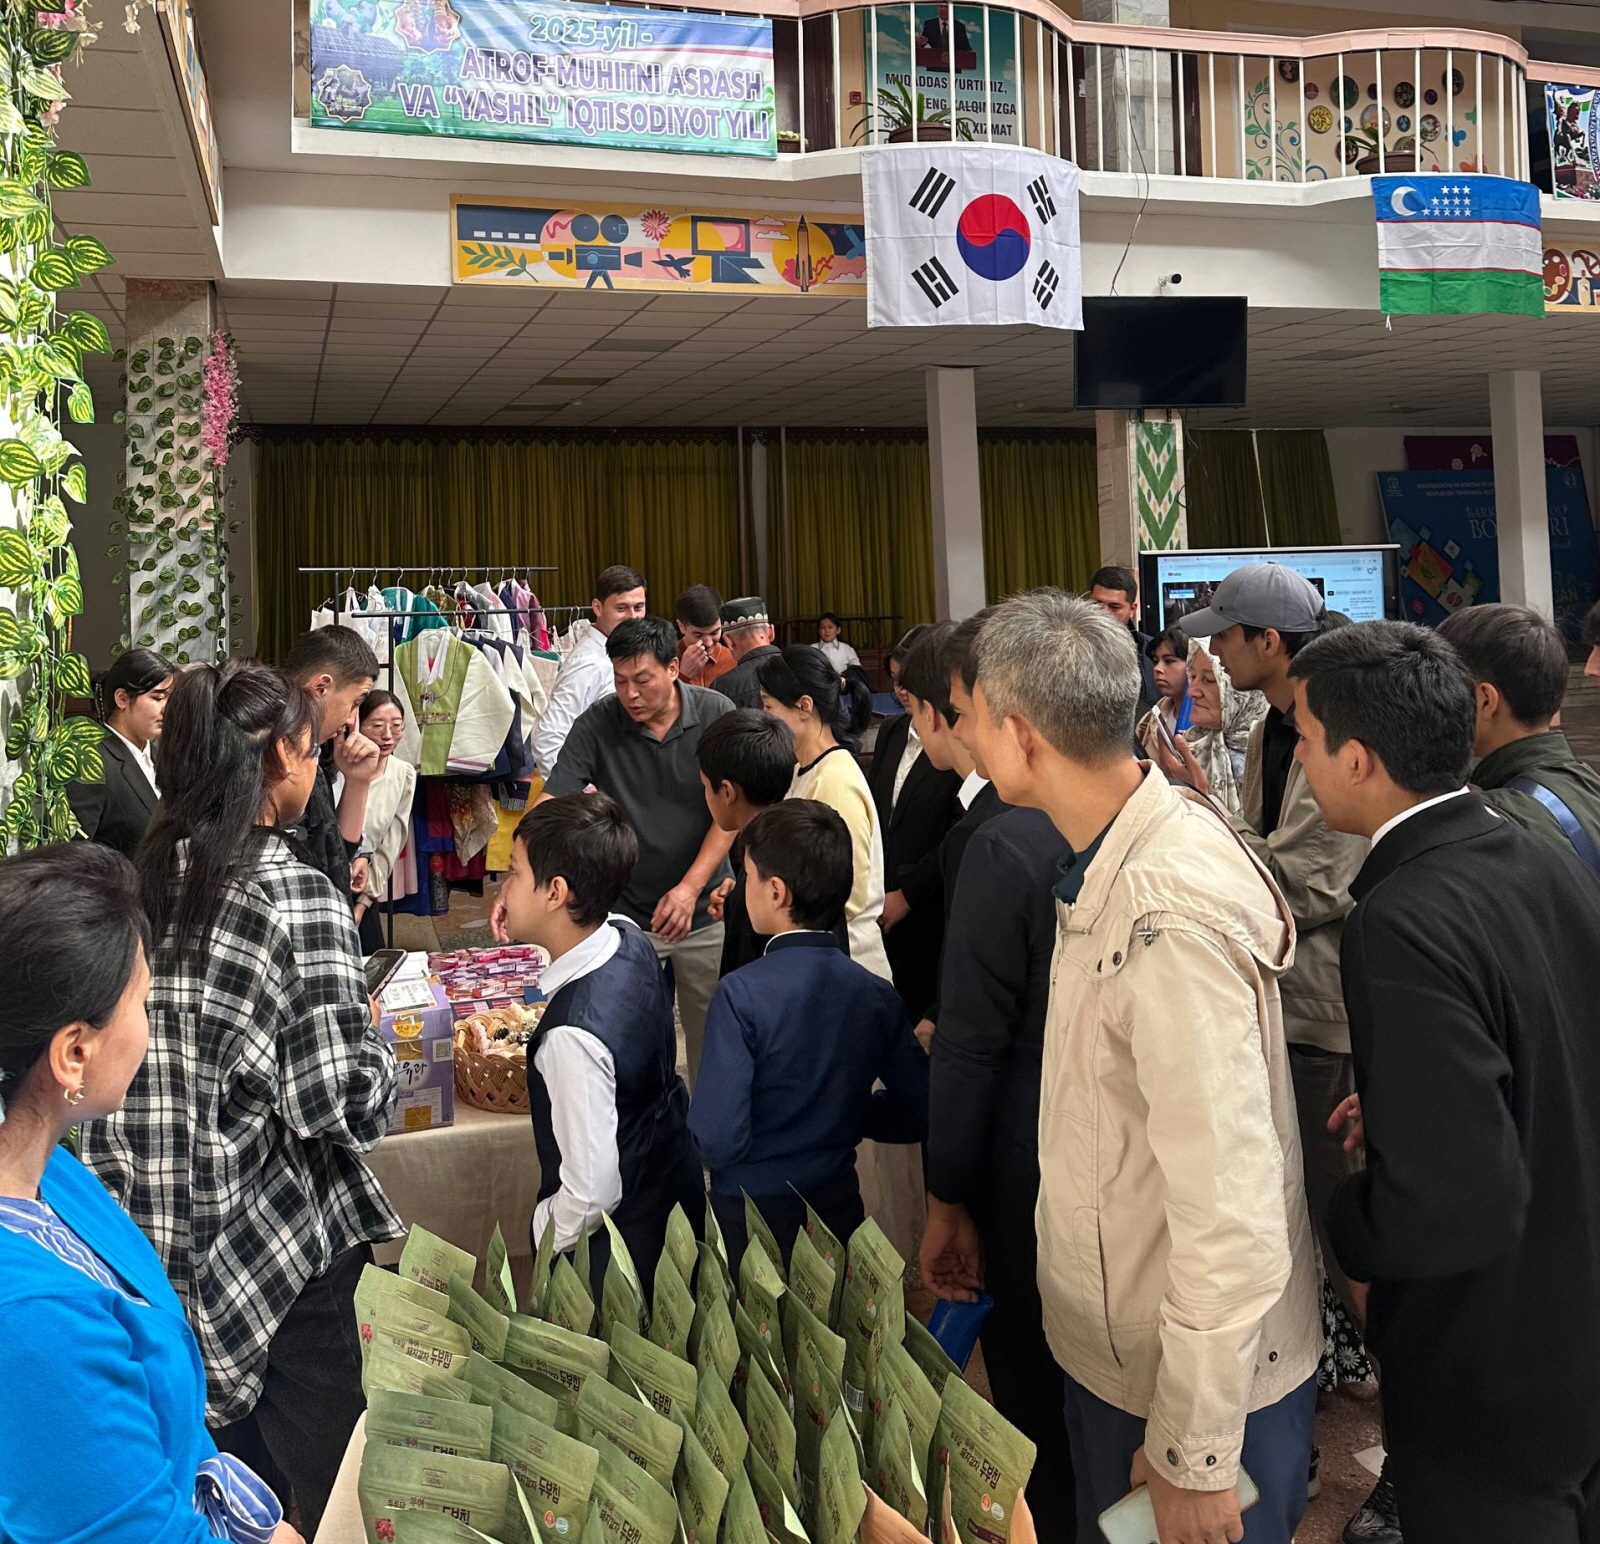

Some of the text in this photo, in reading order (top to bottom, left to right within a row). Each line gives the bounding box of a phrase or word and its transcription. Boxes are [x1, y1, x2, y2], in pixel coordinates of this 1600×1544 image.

[530, 16, 638, 53] 2025-yil
[461, 49, 762, 101] ATROF-MUHITNI ASRASH
[399, 84, 769, 141] VA “YASHIL” IQTISODIYOT YILI
[924, 97, 948, 110] ENG
[431, 1347, 452, 1369] 두부칩
[560, 1370, 580, 1391] 두부칩
[653, 1390, 671, 1415] 두부칩
[979, 1458, 1001, 1490] 두부칩
[539, 1476, 560, 1505] 두부칩
